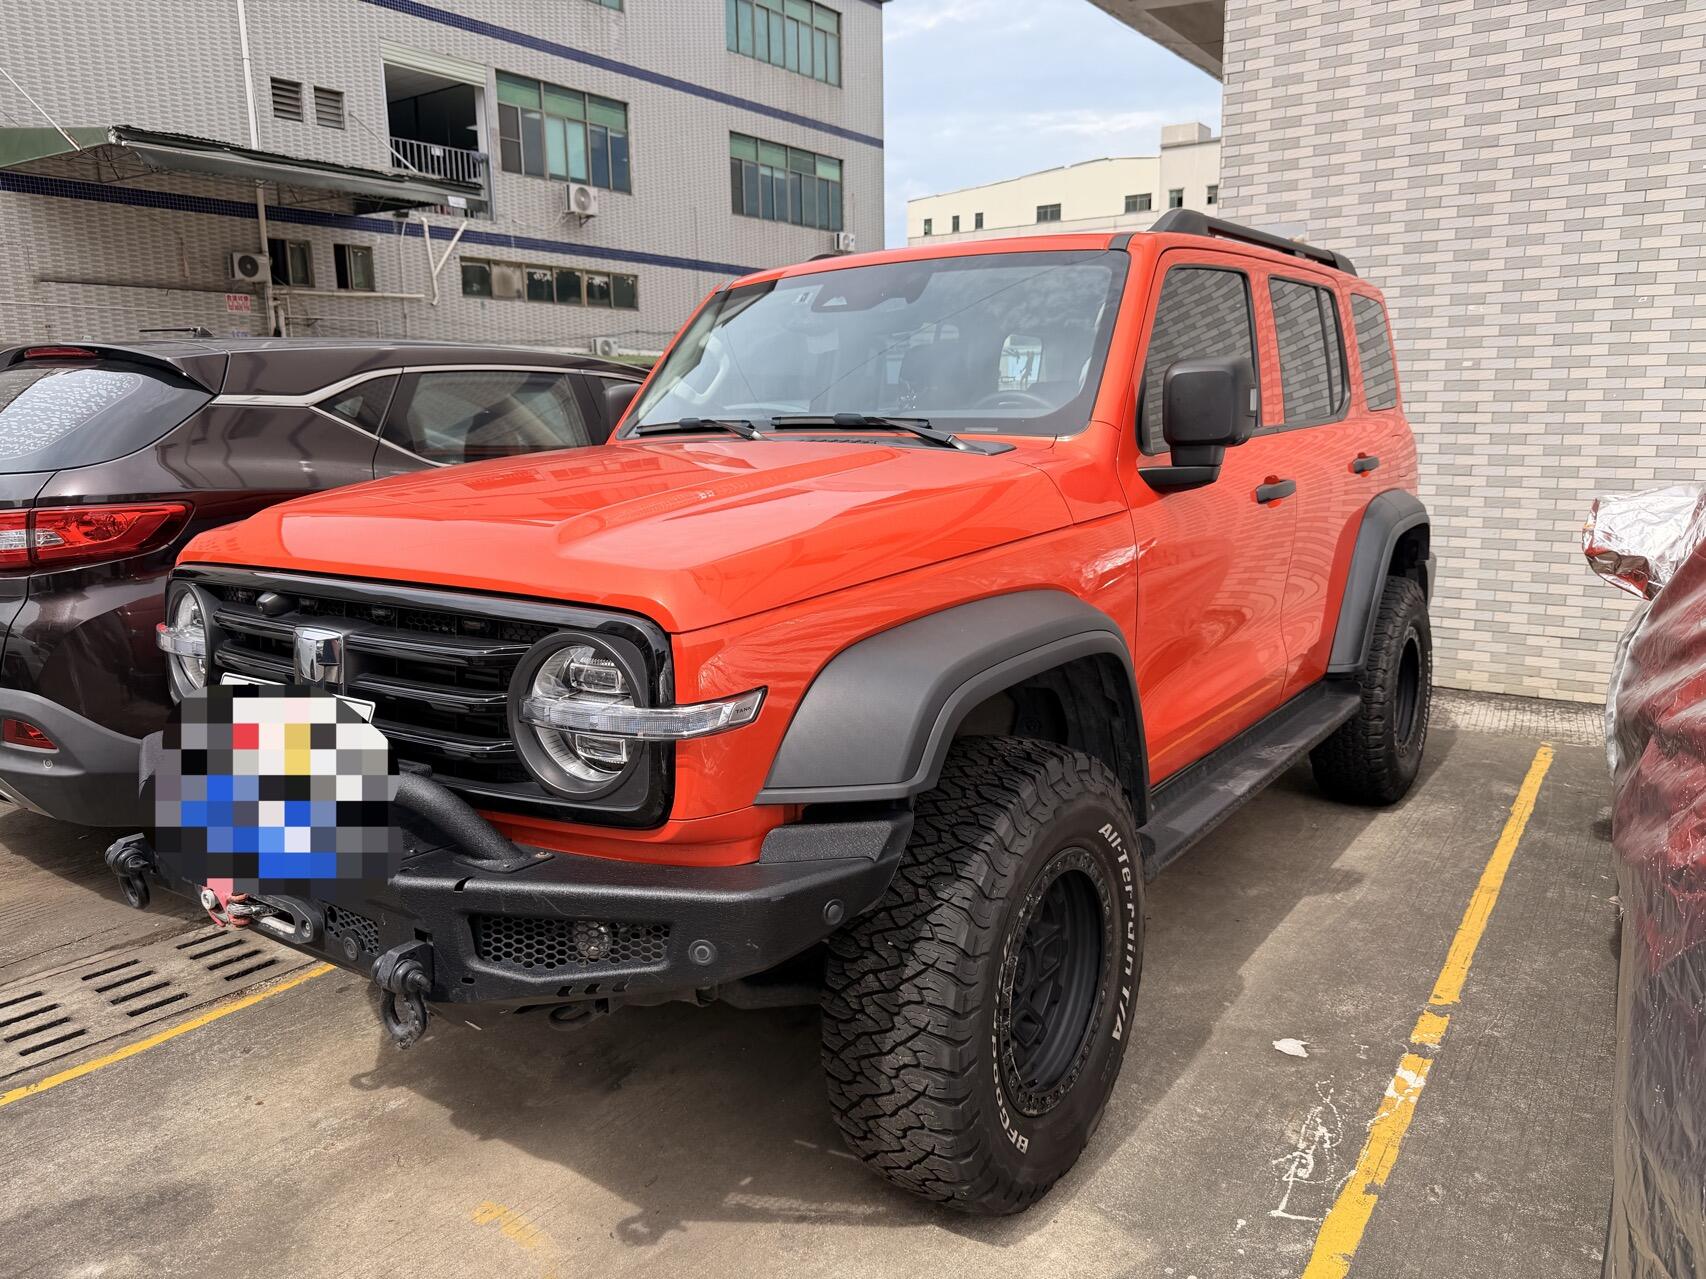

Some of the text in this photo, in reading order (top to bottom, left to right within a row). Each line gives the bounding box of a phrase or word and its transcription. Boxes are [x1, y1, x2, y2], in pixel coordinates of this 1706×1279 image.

[735, 705, 753, 714] TANK
[1098, 823, 1136, 1041] All-Terrain T/A
